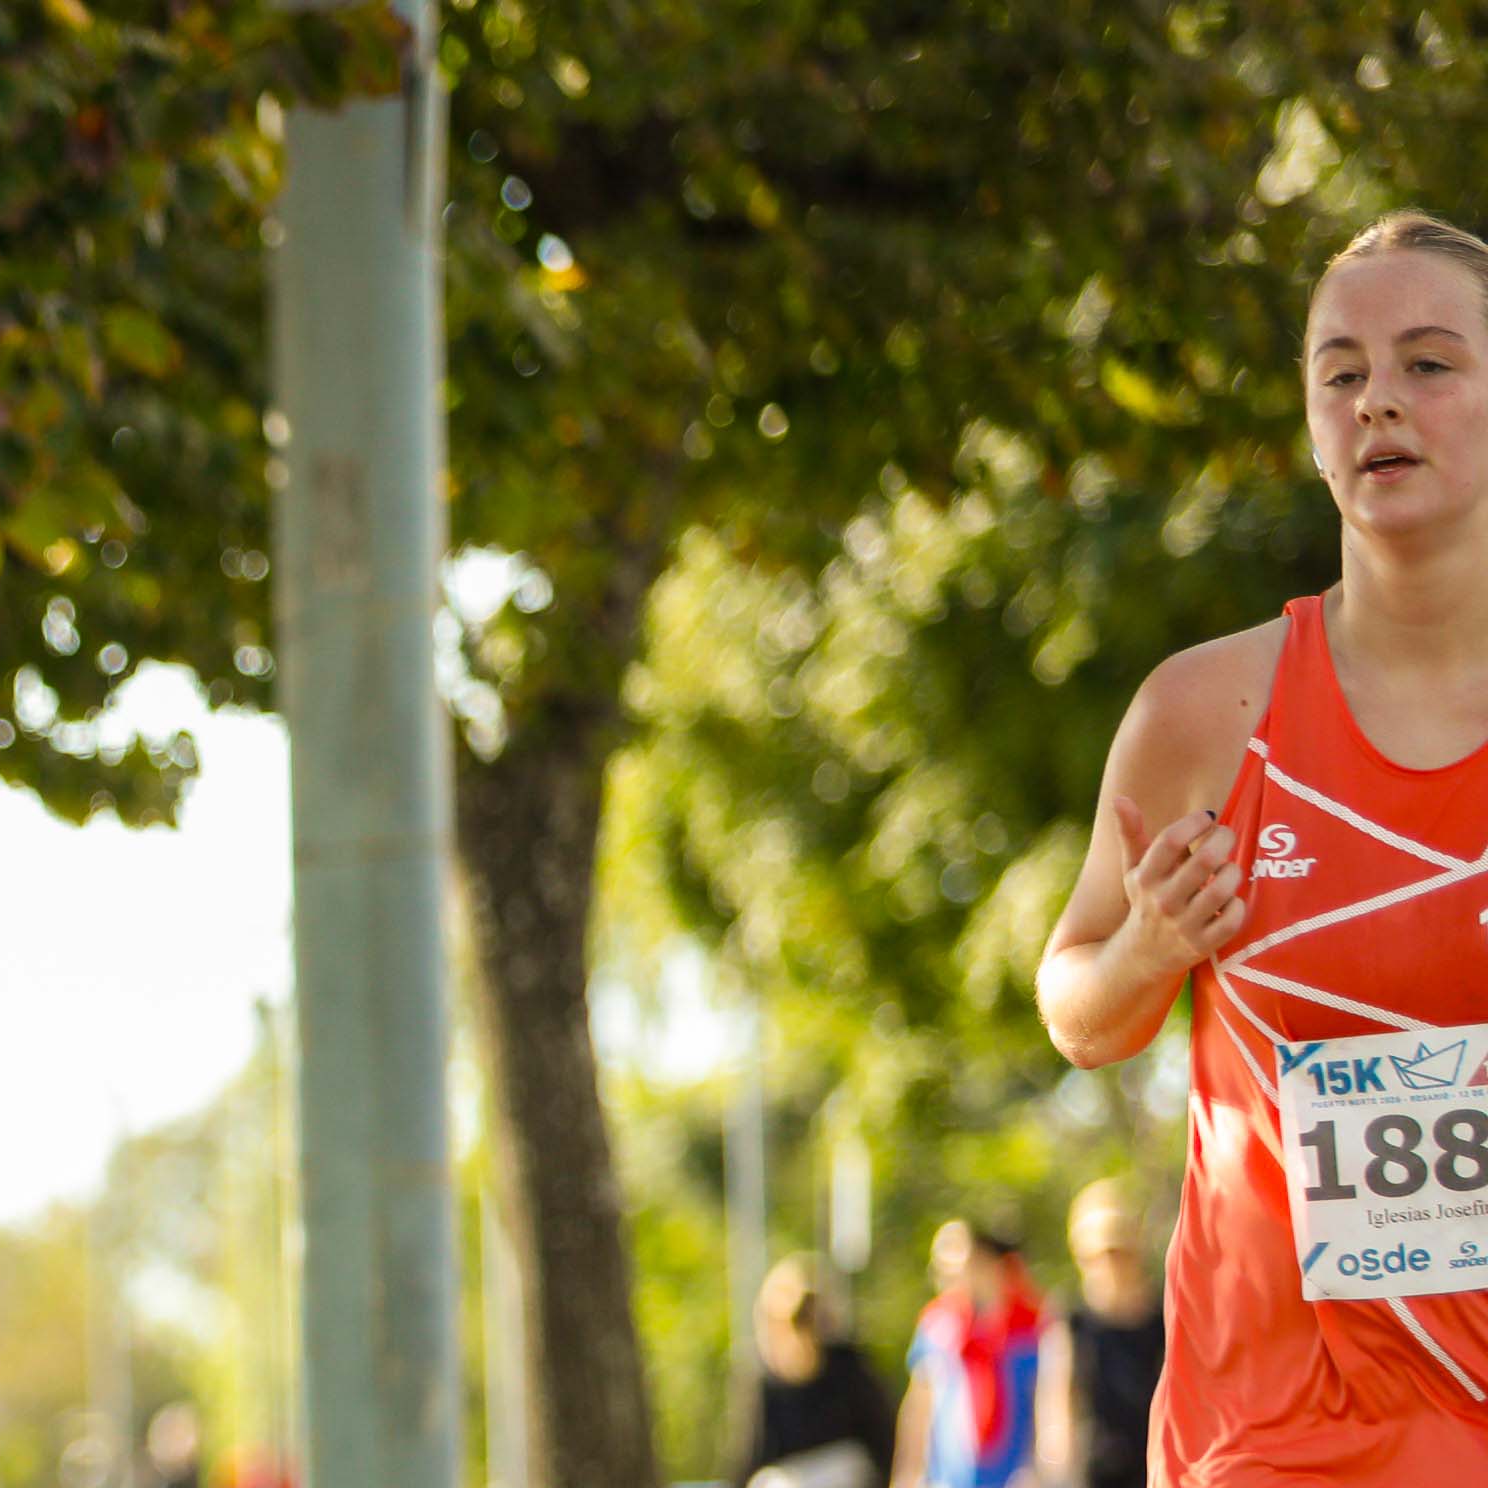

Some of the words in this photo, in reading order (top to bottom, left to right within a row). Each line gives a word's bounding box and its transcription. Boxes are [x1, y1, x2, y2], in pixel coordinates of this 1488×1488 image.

[1307, 1057, 1387, 1096] 15K
[1366, 1206, 1431, 1229] Iglesias
[1336, 1241, 1431, 1281] osde
